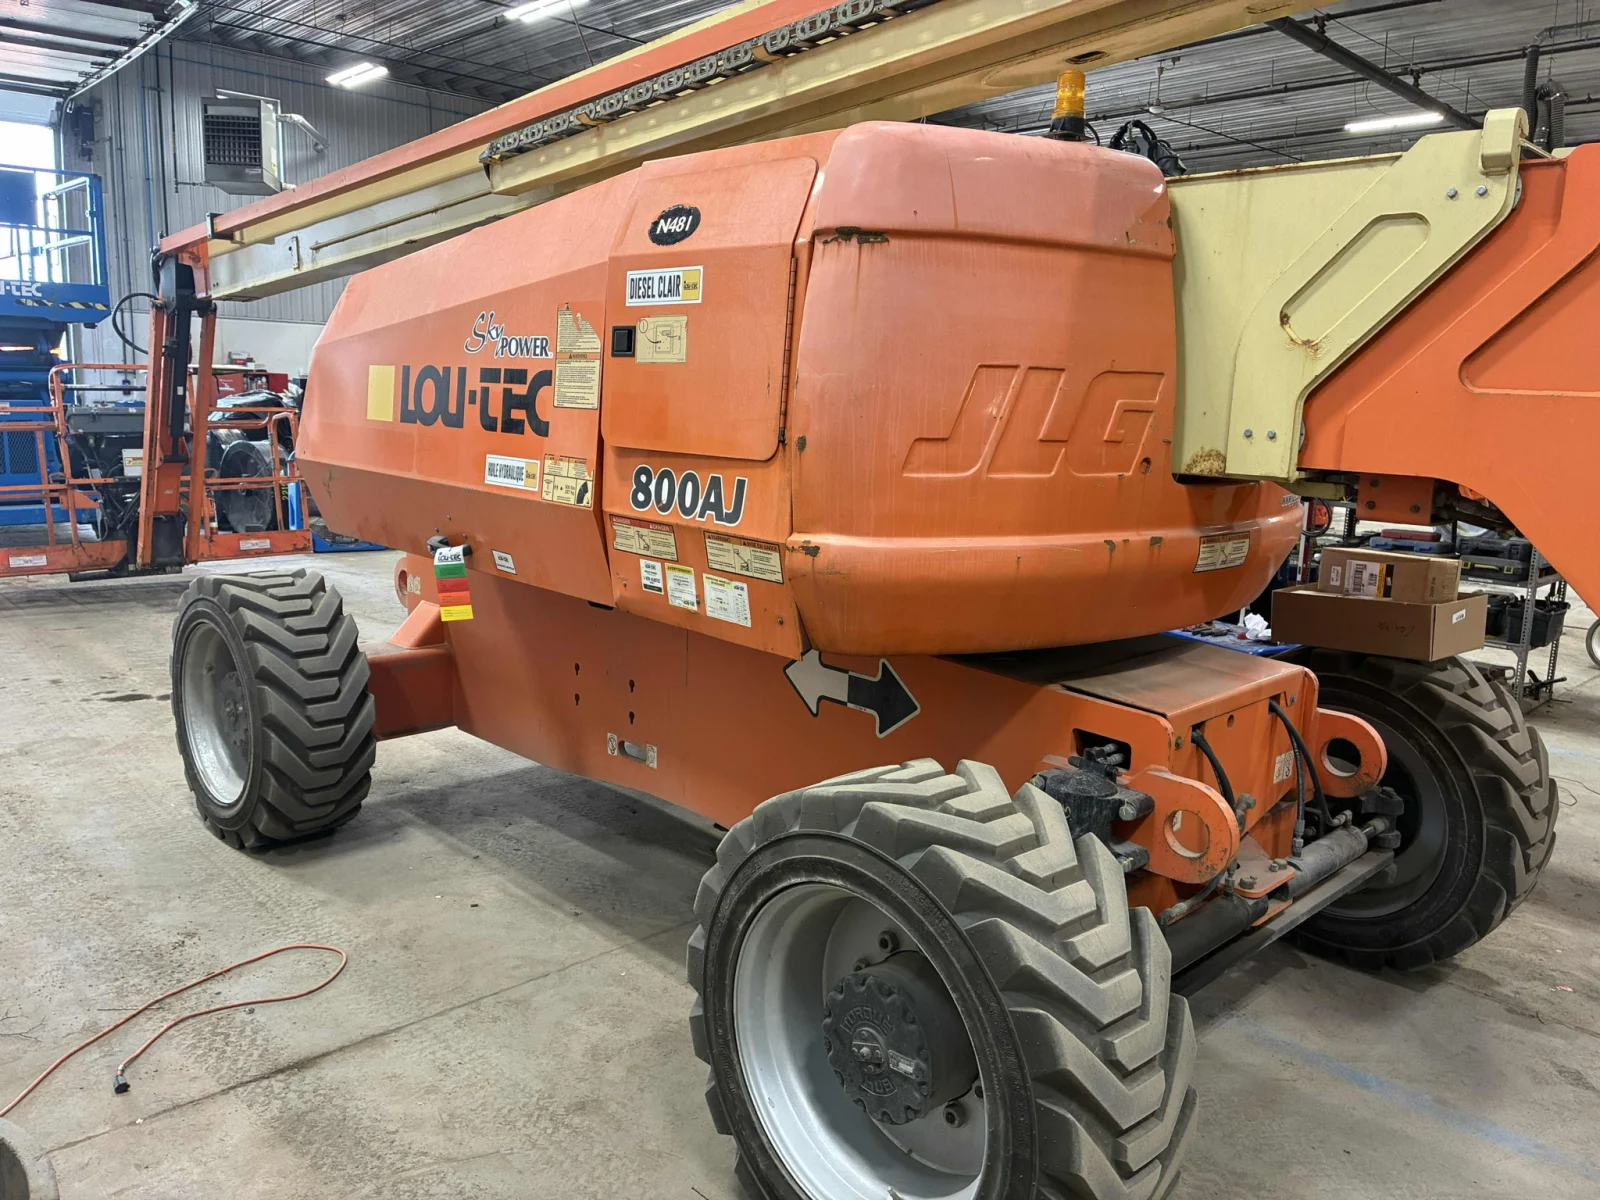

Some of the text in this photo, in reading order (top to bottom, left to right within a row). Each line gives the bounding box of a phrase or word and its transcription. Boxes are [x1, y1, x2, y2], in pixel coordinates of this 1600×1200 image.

[656, 215, 693, 234] N481
[0, 280, 42, 297] -TEC
[629, 274, 681, 299] DIESEL CLAIR
[464, 311, 549, 358] Sky POWER
[400, 365, 552, 437] LOU-TEC
[902, 364, 1165, 477] JLG
[630, 464, 748, 527] 800AJ
